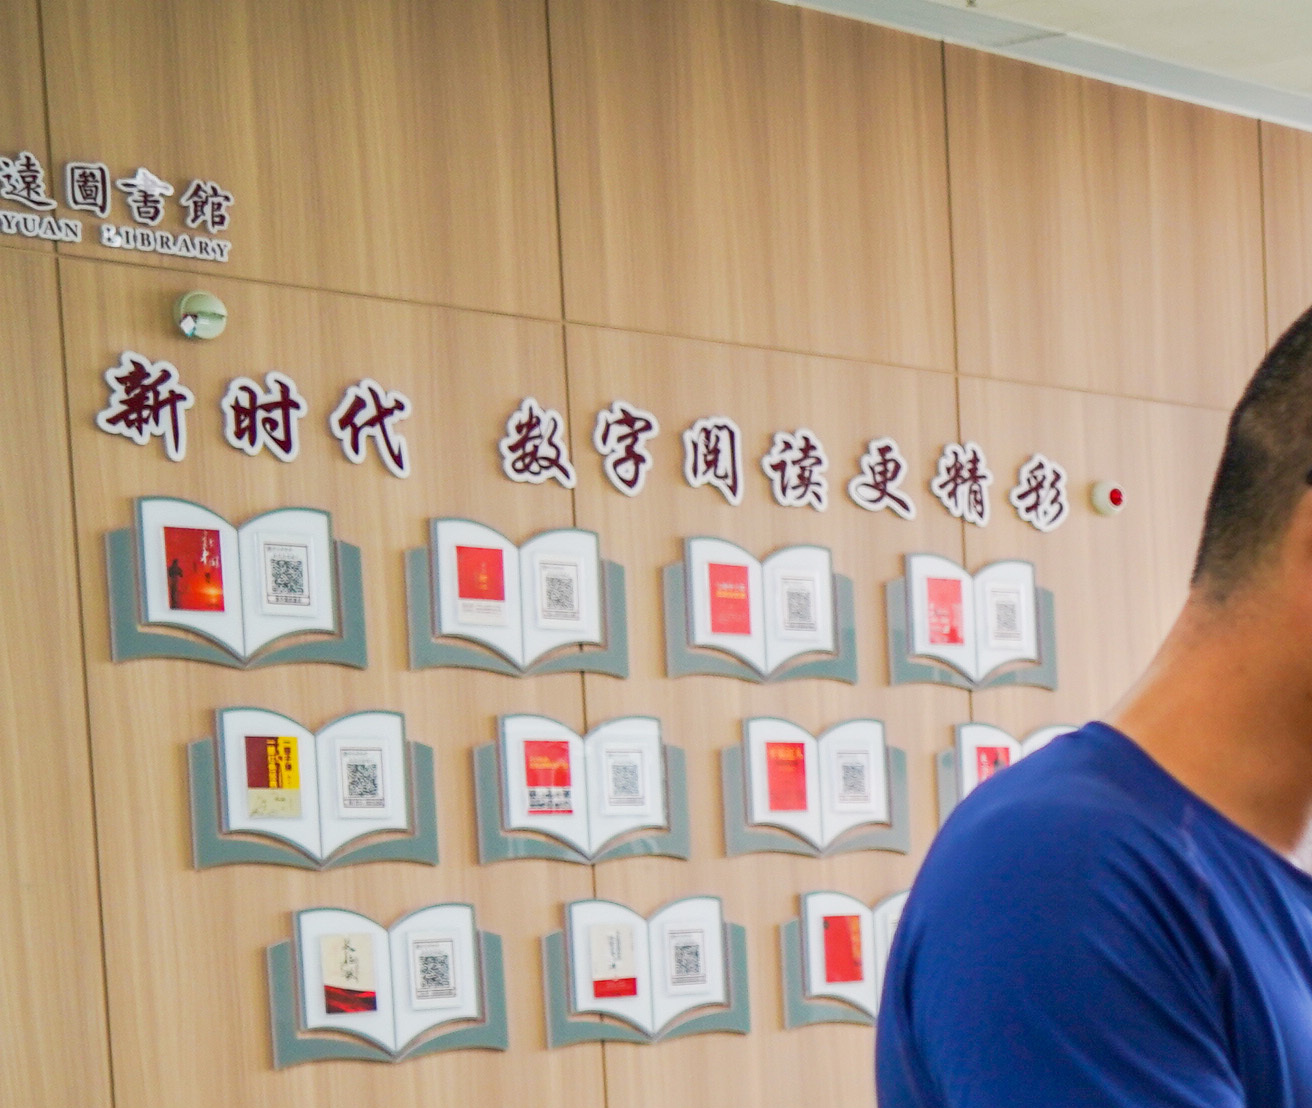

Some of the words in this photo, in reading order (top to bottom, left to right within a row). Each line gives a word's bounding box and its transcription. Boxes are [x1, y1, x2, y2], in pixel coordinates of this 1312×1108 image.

[2, 214, 82, 239] YUAN
[101, 356, 409, 474] 新时代
[504, 401, 1069, 528] 数字阅读更精彩
